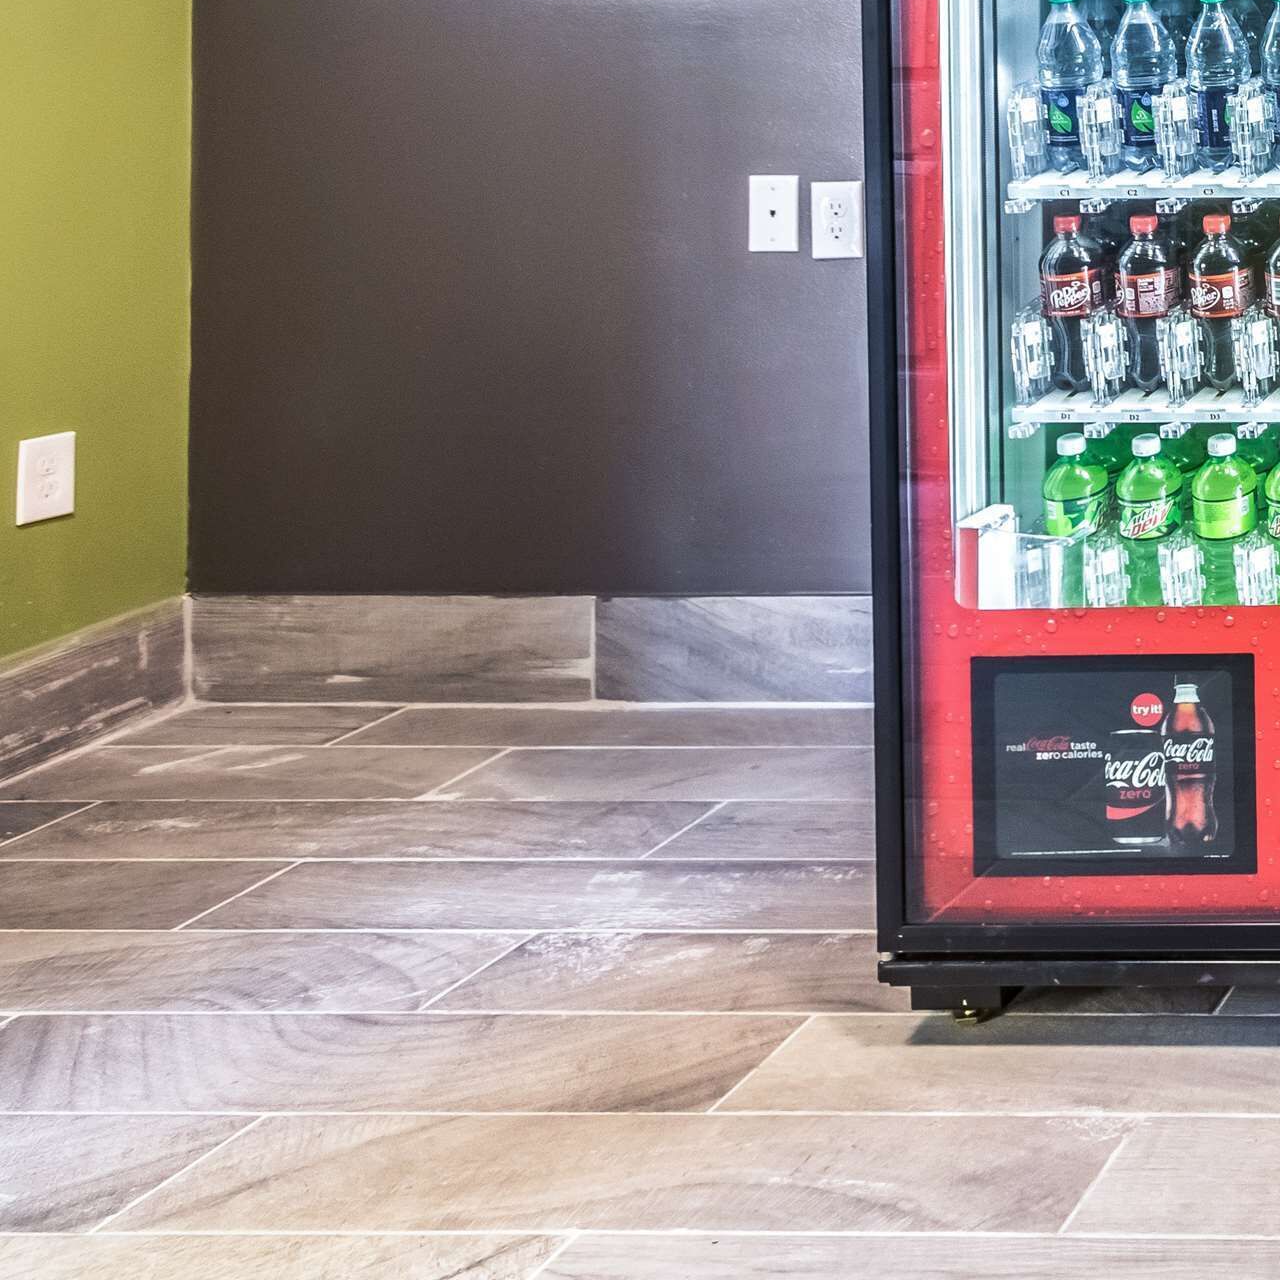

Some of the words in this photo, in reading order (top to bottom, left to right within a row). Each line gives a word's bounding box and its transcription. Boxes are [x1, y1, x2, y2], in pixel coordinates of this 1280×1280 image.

[1050, 289, 1090, 310] Pepper
[1060, 412, 1071, 420] D1
[1132, 704, 1150, 716] try
[1151, 704, 1163, 714] it!
[1006, 742, 1026, 752] real
[1026, 735, 1071, 752] Coca-Cola
[1070, 740, 1097, 750] taste
[1036, 751, 1060, 761] zero
[1061, 749, 1103, 760] calories
[1178, 762, 1200, 770] zero
[1120, 788, 1151, 800] zero
